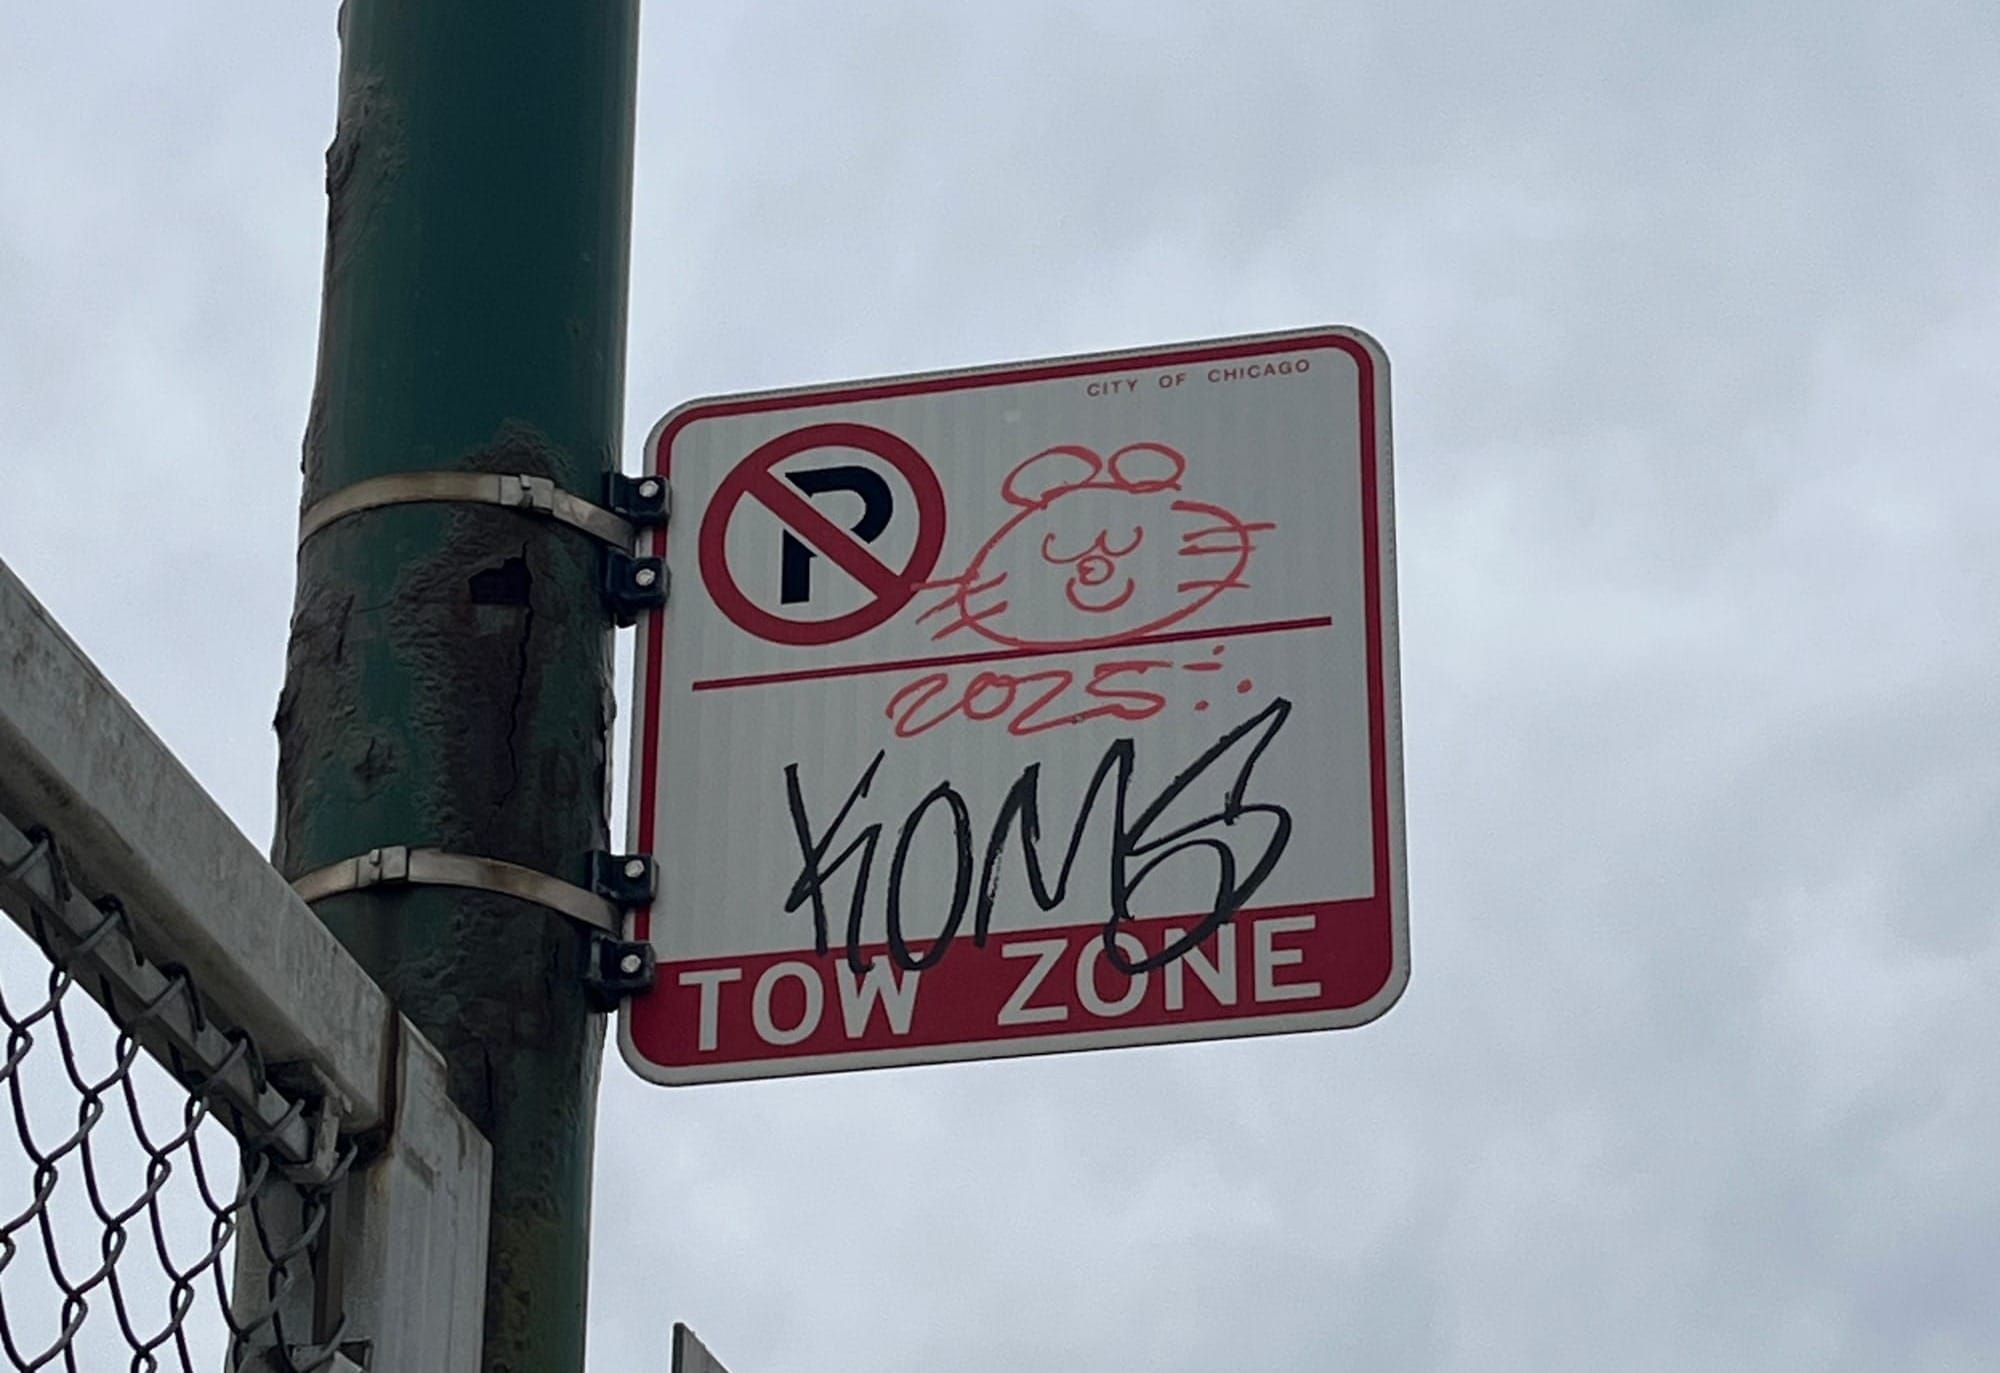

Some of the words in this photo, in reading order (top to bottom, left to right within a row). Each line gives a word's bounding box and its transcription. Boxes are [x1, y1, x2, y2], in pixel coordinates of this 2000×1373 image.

[1086, 378, 1139, 398] CITY
[1158, 371, 1188, 389] OF
[1206, 358, 1311, 384] CHICAGO
[678, 951, 922, 1052] TOW
[996, 914, 1323, 1027] ZONE
